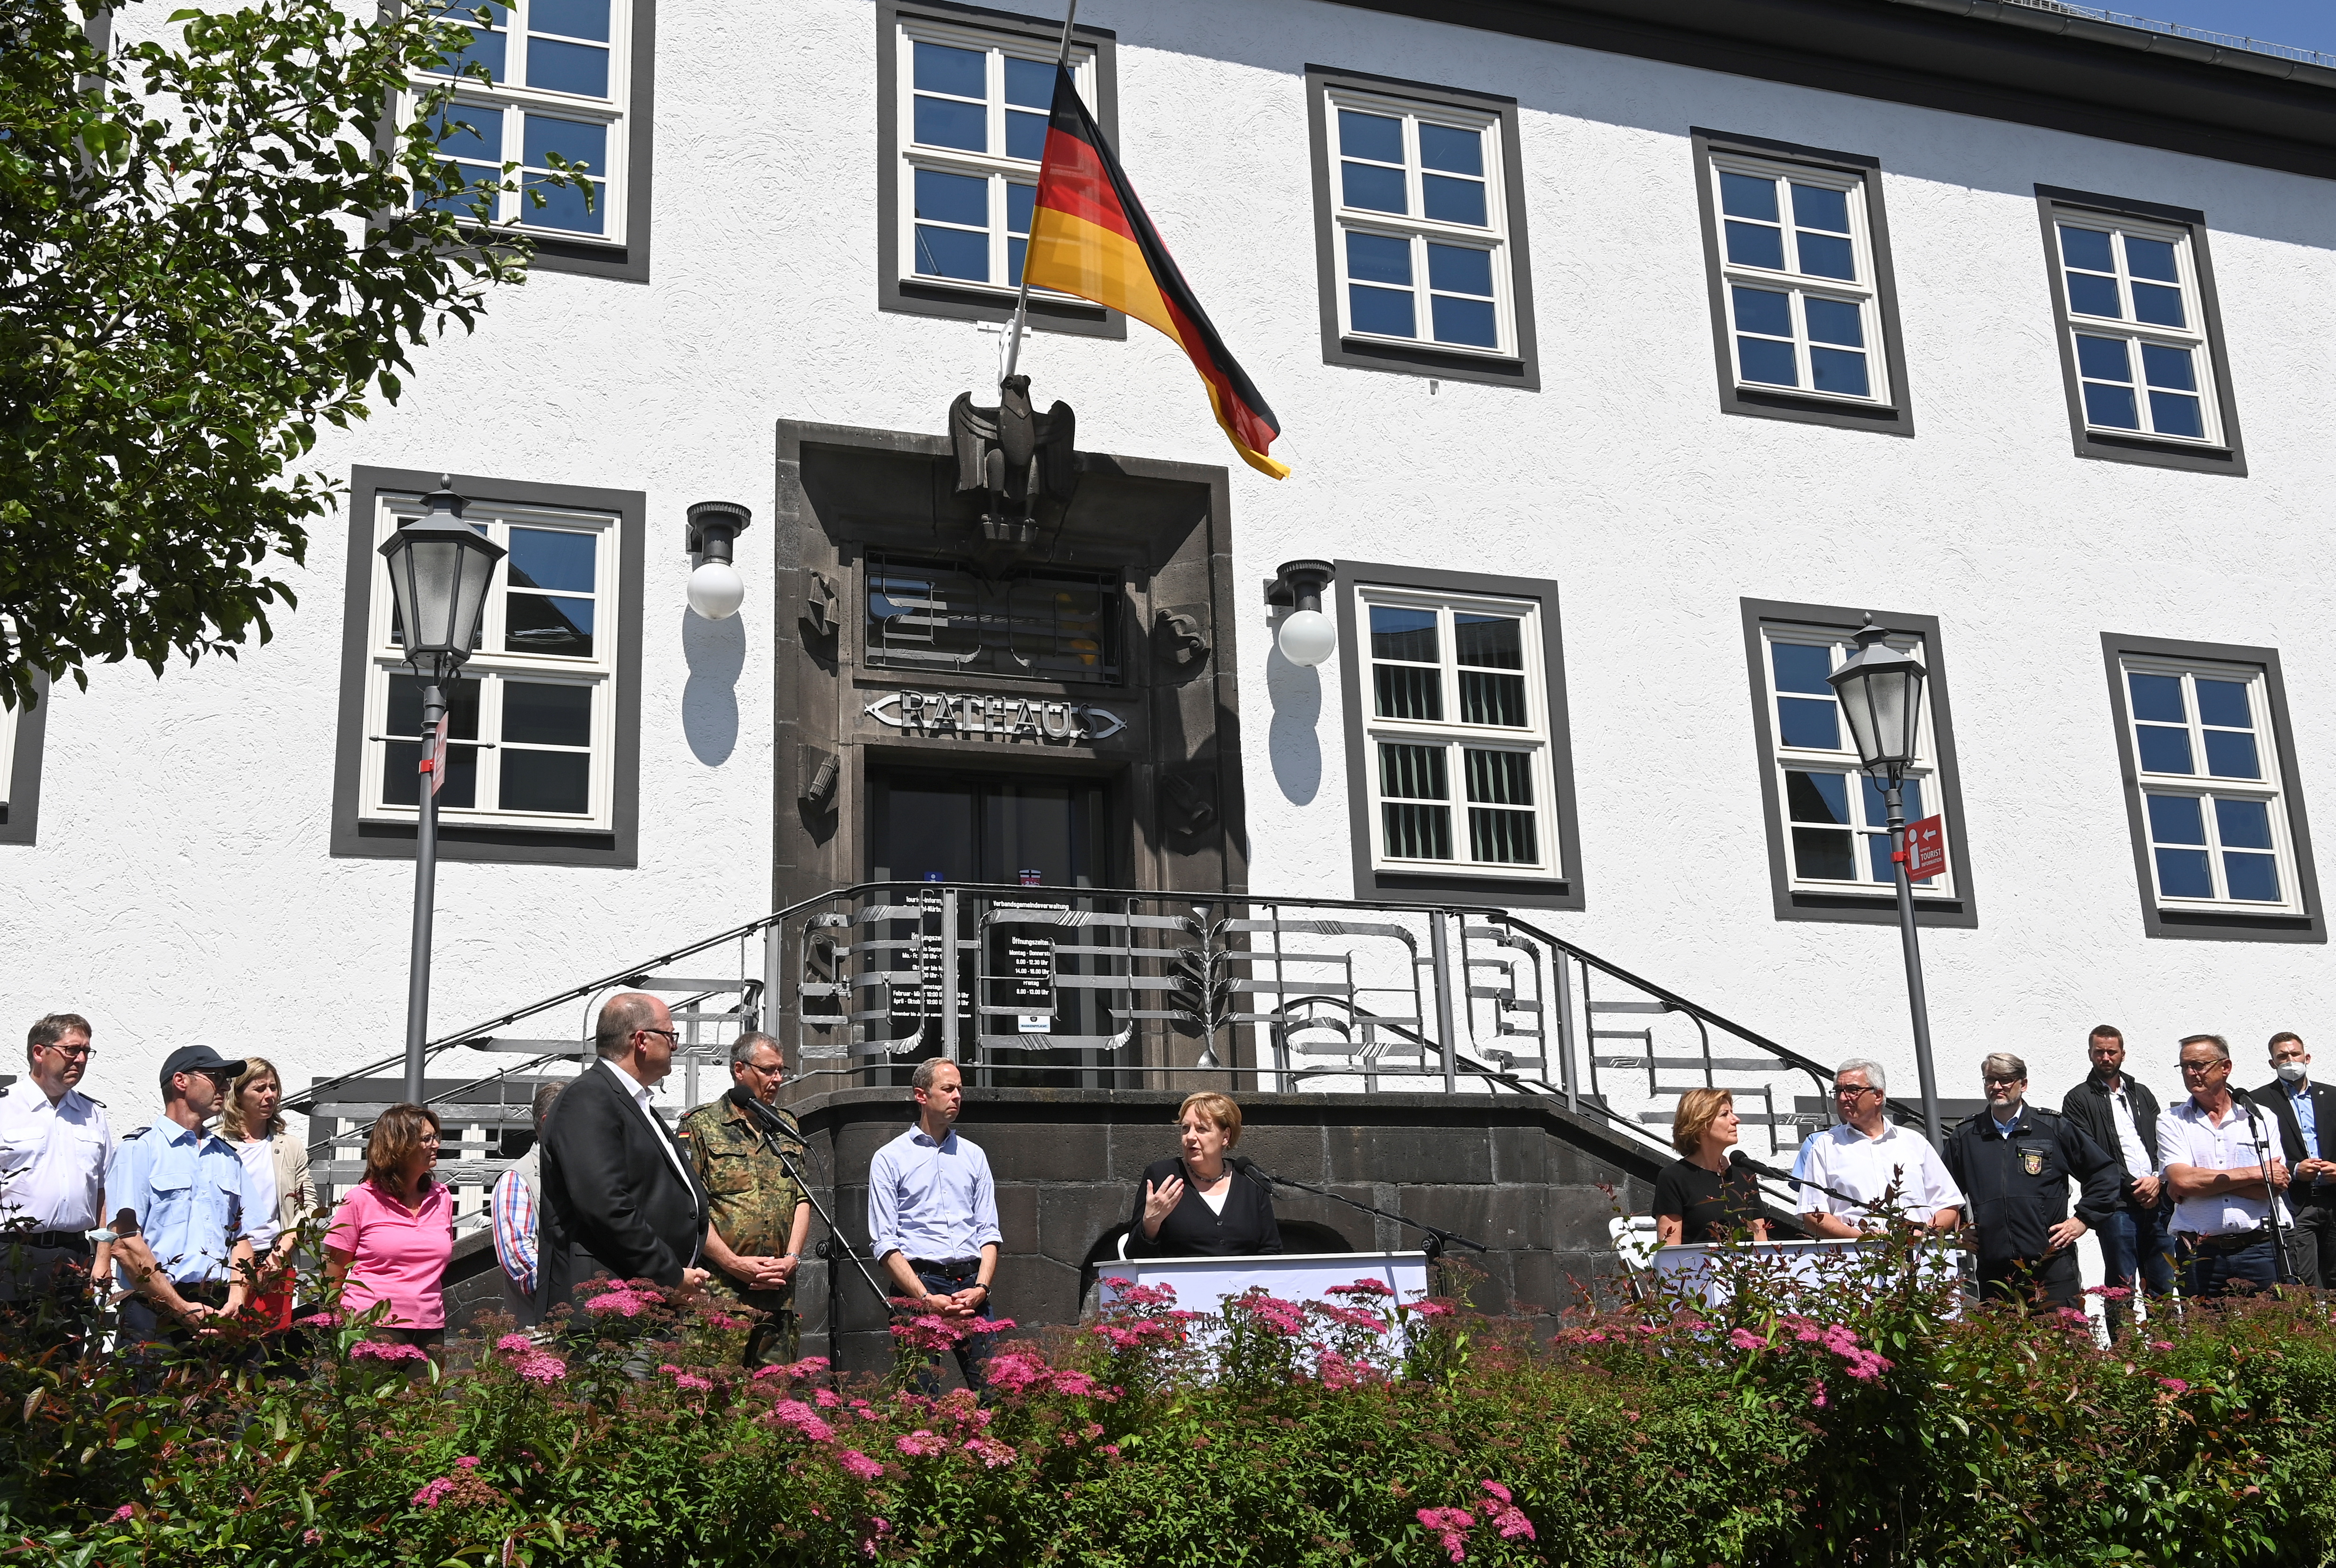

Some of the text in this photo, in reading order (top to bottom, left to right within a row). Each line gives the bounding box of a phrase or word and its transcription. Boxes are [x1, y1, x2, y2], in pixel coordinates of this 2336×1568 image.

[900, 690, 1096, 739] RATHAUS
[1921, 848, 1941, 860] TOURIST
[1921, 857, 1942, 867] INFORMATION
[993, 901, 1069, 910] Verbandsgemeindeverwaltung
